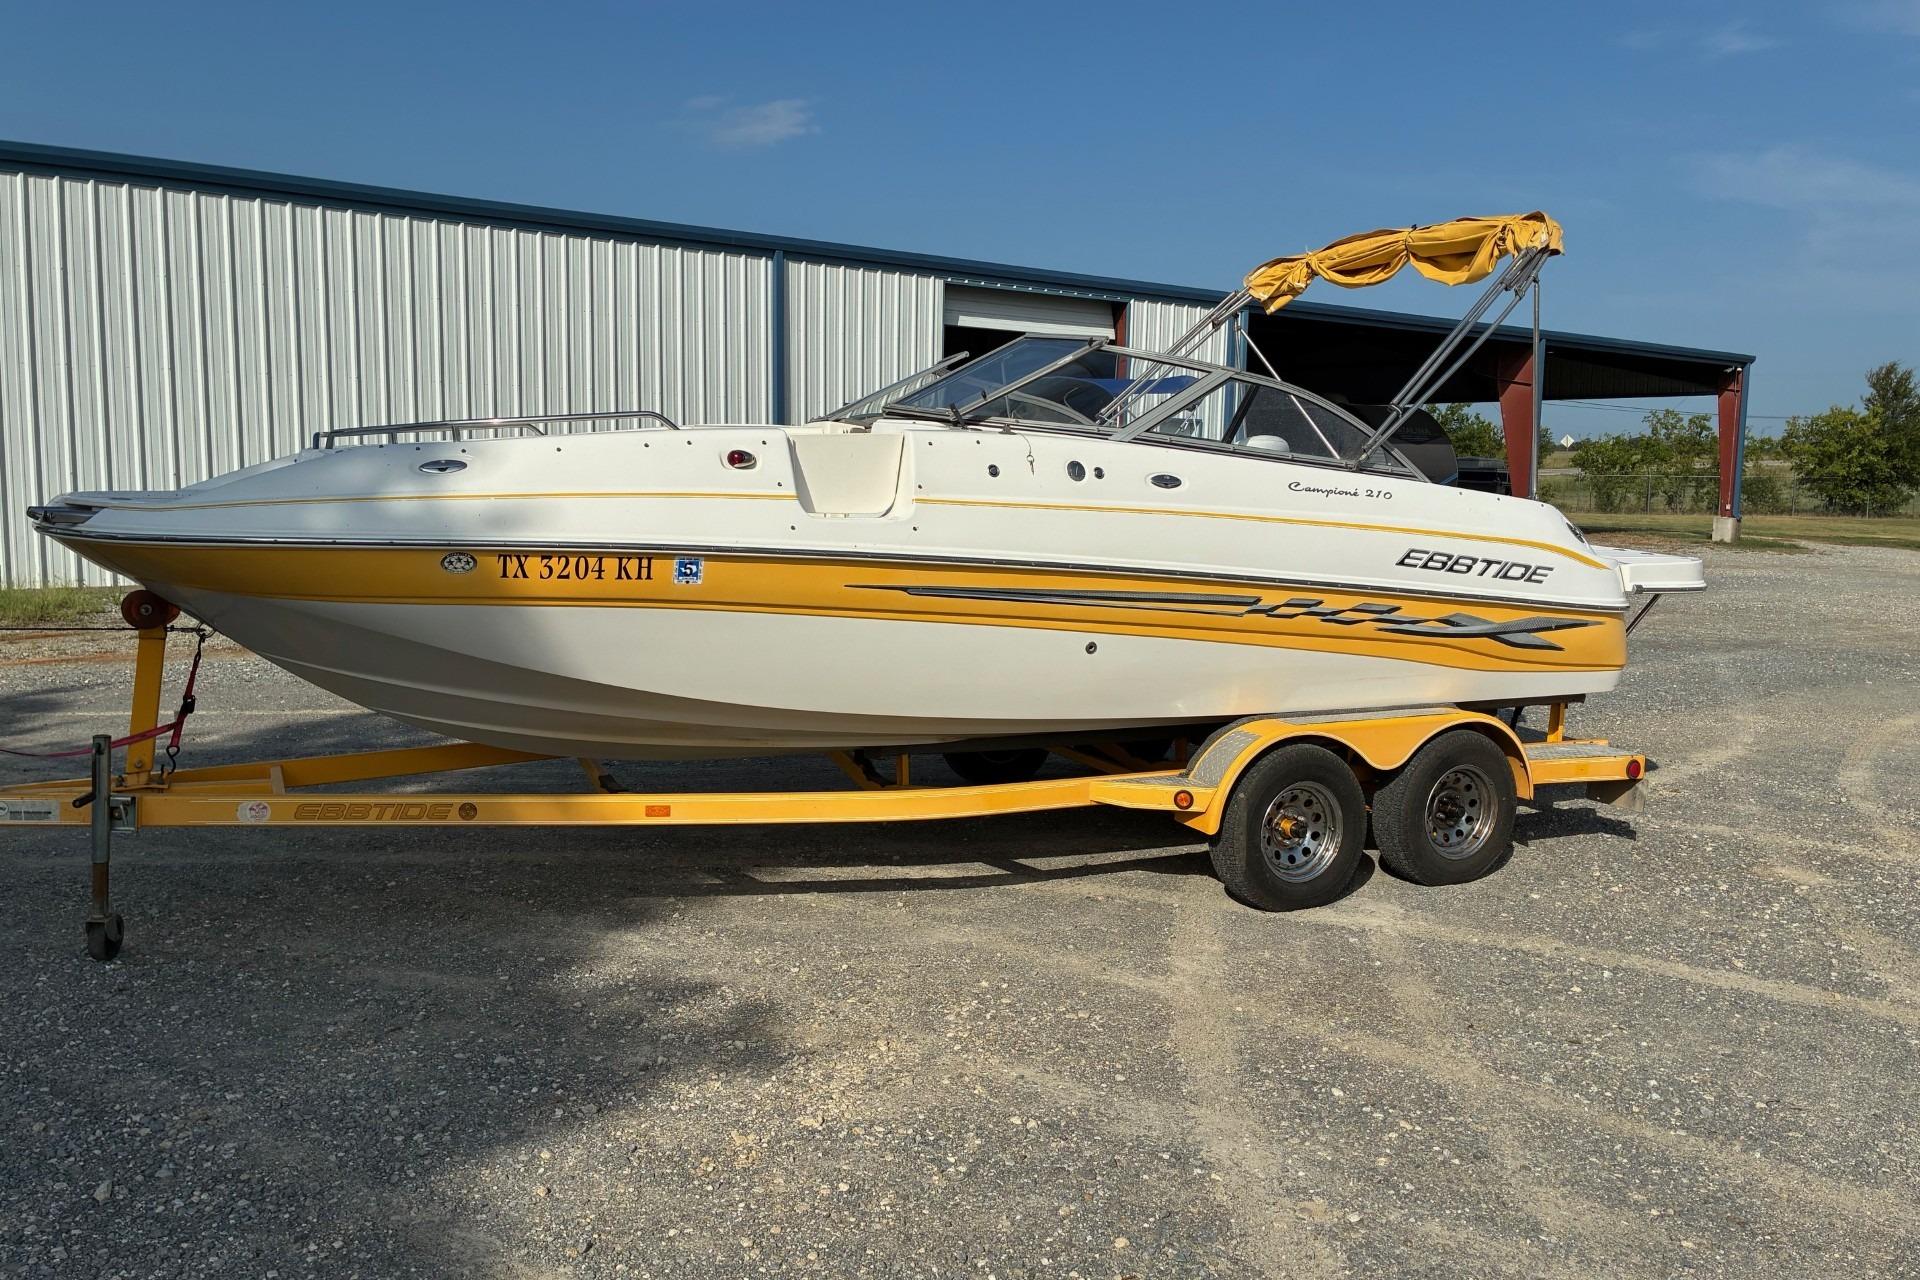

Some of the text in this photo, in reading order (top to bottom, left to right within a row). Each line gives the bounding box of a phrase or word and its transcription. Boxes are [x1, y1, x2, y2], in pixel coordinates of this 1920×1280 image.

[1365, 489, 1392, 500] 210
[497, 553, 654, 580] TX 3204 KH
[684, 562, 693, 577] 5
[1395, 548, 1554, 584] EBBTIDE
[294, 803, 454, 820] EBBTIDE
